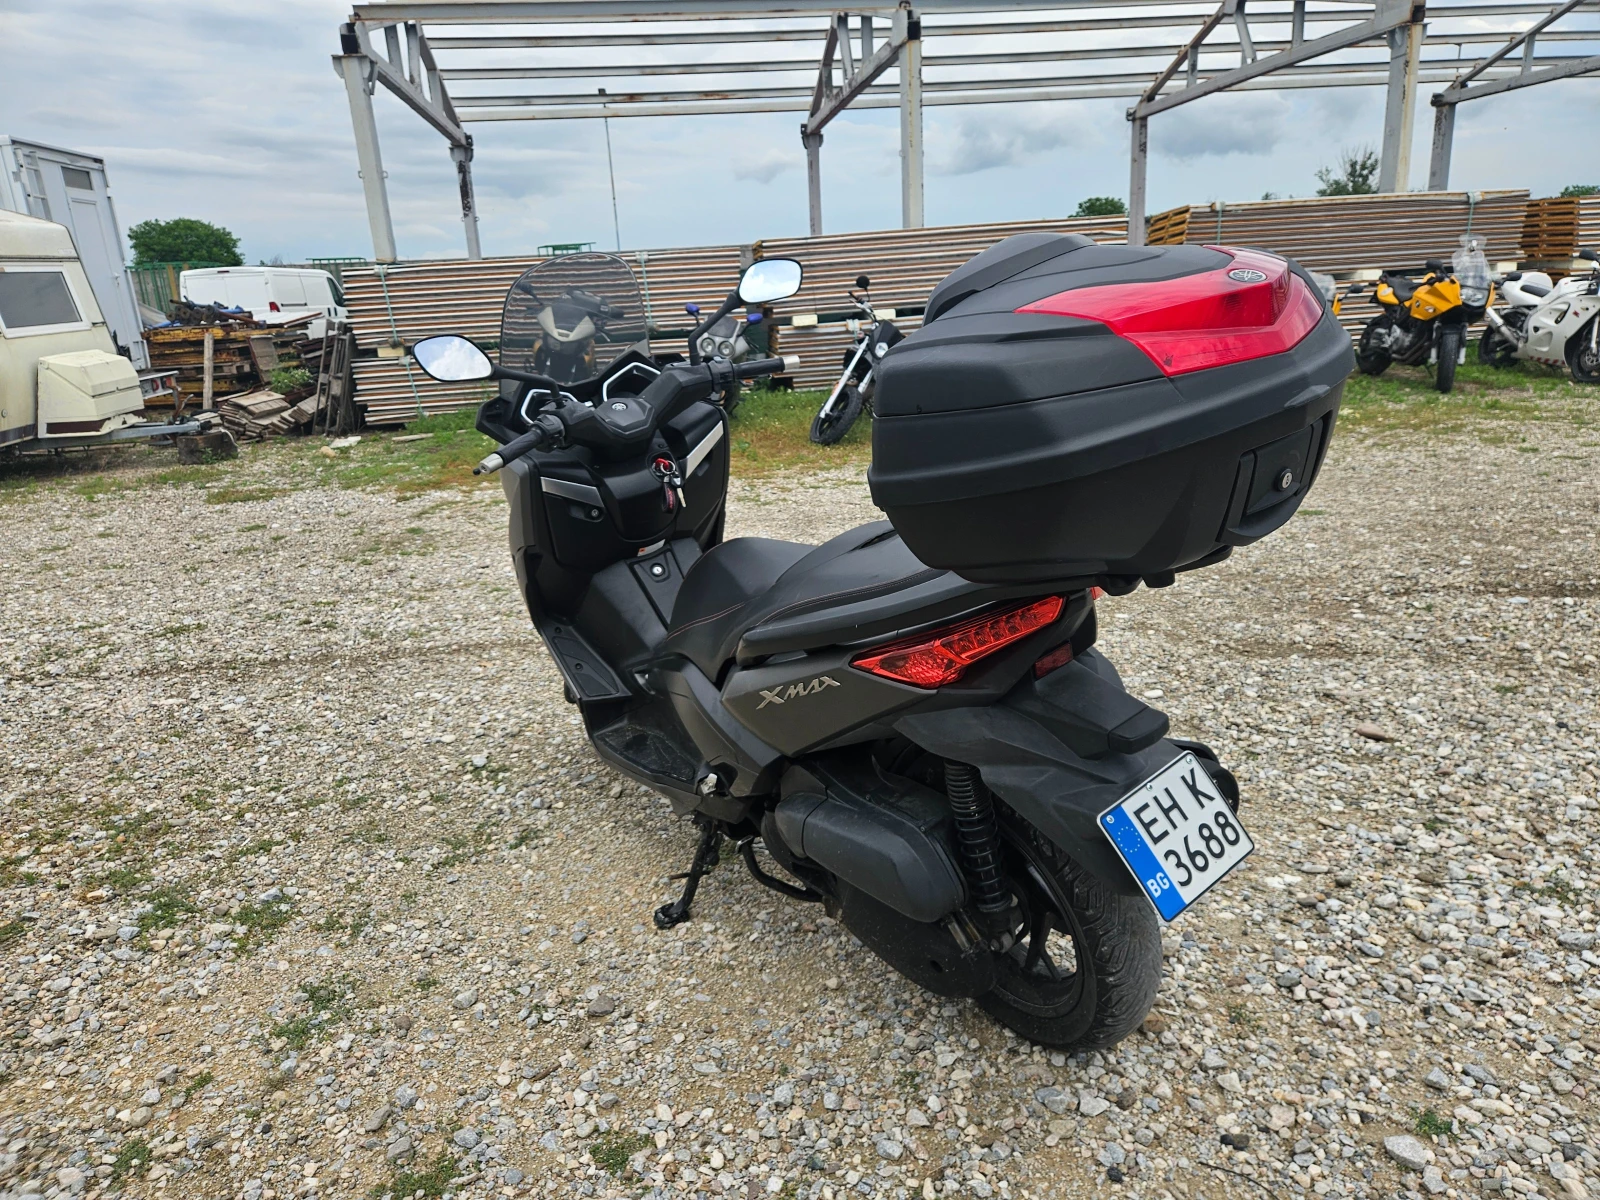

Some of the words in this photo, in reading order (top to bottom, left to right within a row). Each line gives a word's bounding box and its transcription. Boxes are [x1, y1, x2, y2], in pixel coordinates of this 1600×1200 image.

[756, 676, 841, 710] XMAX
[1133, 787, 1189, 845] EH
[1180, 767, 1216, 810] K
[1163, 810, 1240, 887] 3688
[1146, 872, 1171, 898] BG
